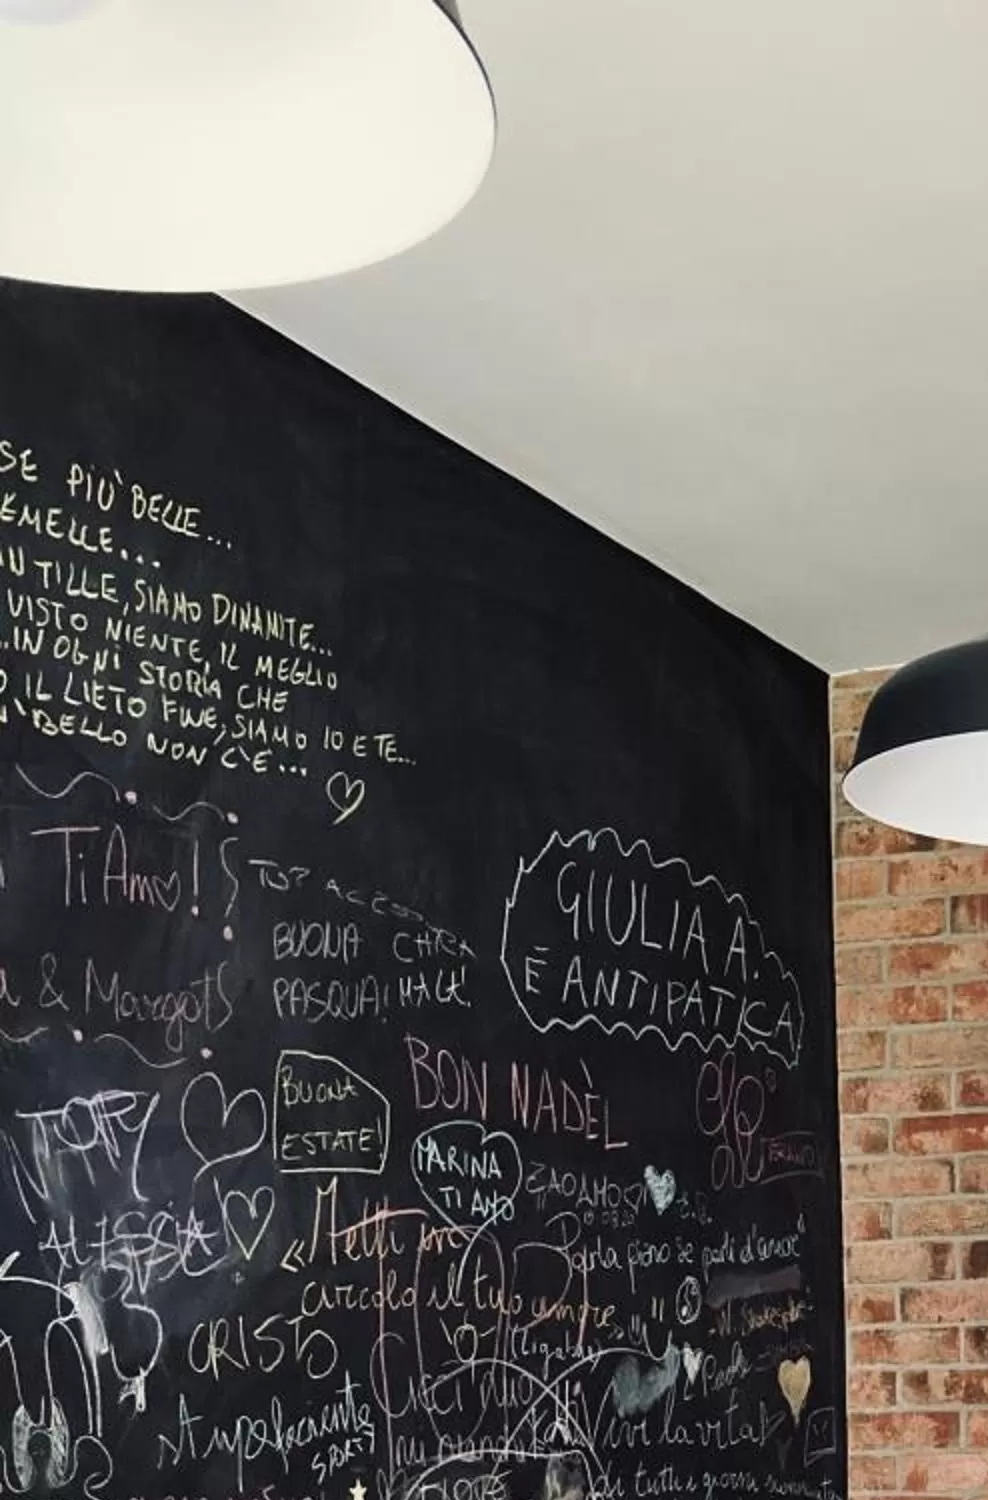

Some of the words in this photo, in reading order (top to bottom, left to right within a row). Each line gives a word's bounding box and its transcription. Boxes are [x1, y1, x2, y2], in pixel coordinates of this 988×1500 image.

[8, 588, 88, 632] VISTO
[256, 655, 338, 690] MEGLIO
[32, 706, 127, 748] BELLO
[147, 730, 207, 767] NON
[63, 671, 147, 718] LIETO
[234, 713, 308, 750] SIAMO
[237, 683, 289, 713] CHE
[557, 861, 709, 975] GIULIA
[562, 954, 796, 1050] ANTIPATICA
[404, 1034, 488, 1121] BON
